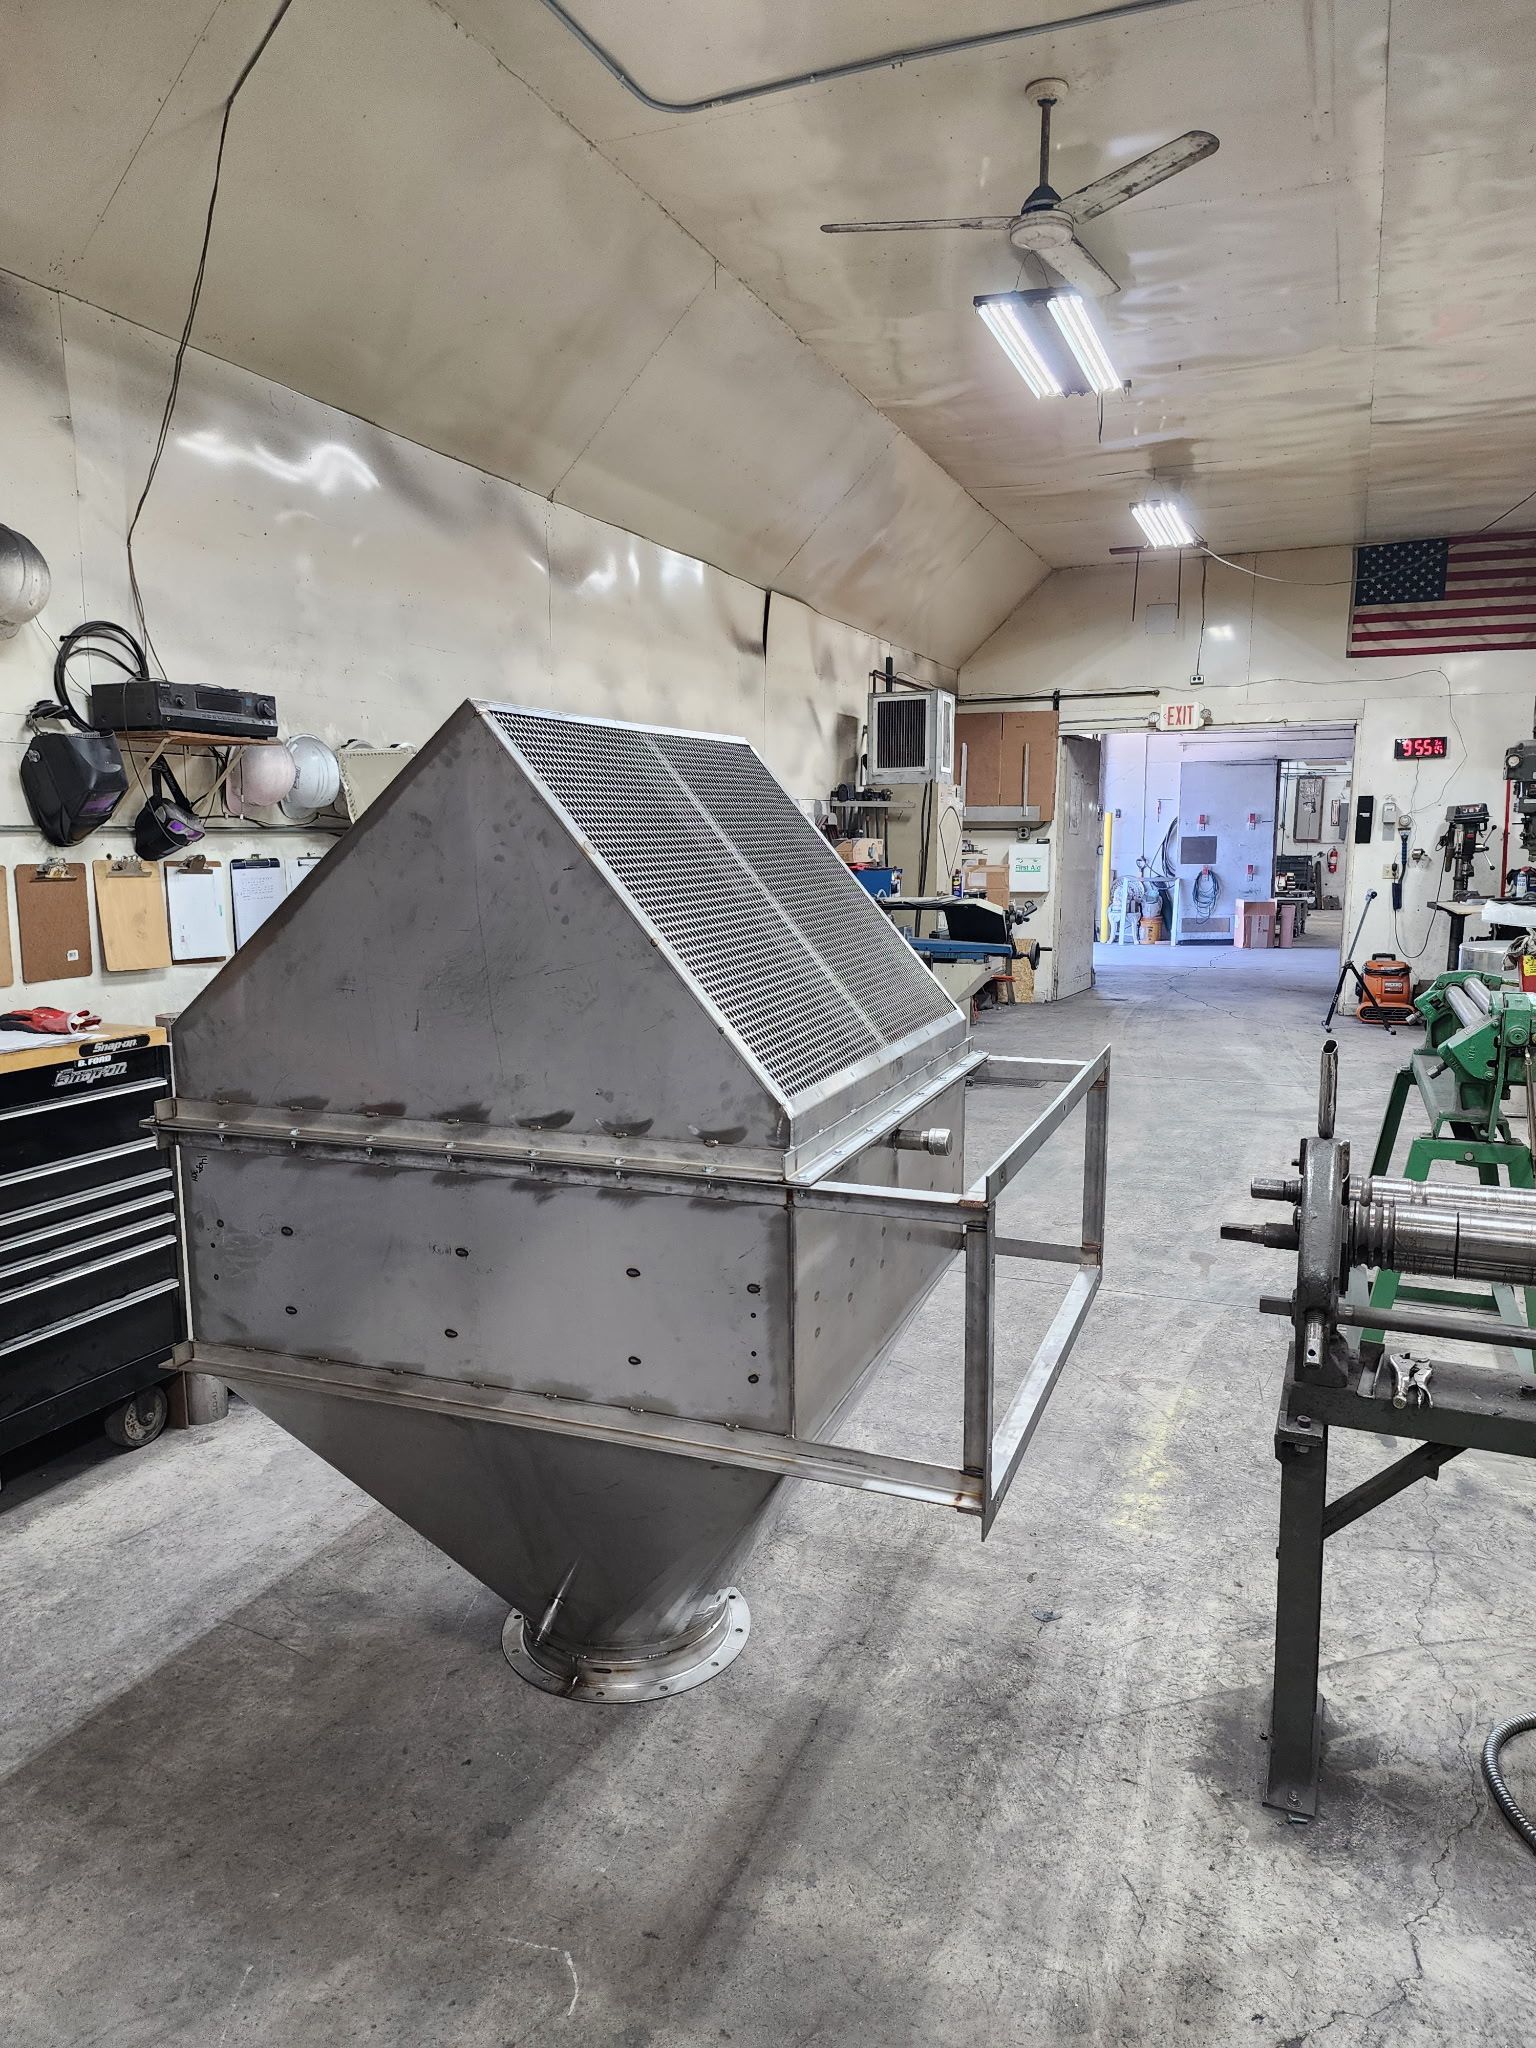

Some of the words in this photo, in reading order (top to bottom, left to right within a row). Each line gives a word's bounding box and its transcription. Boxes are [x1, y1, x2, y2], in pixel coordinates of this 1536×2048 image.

[1167, 705, 1194, 726] EXIT
[93, 1038, 138, 1054] Snap-on
[77, 1059, 87, 1068] B.
[88, 1054, 112, 1066] FORD
[53, 1061, 128, 1088] Snap-on
